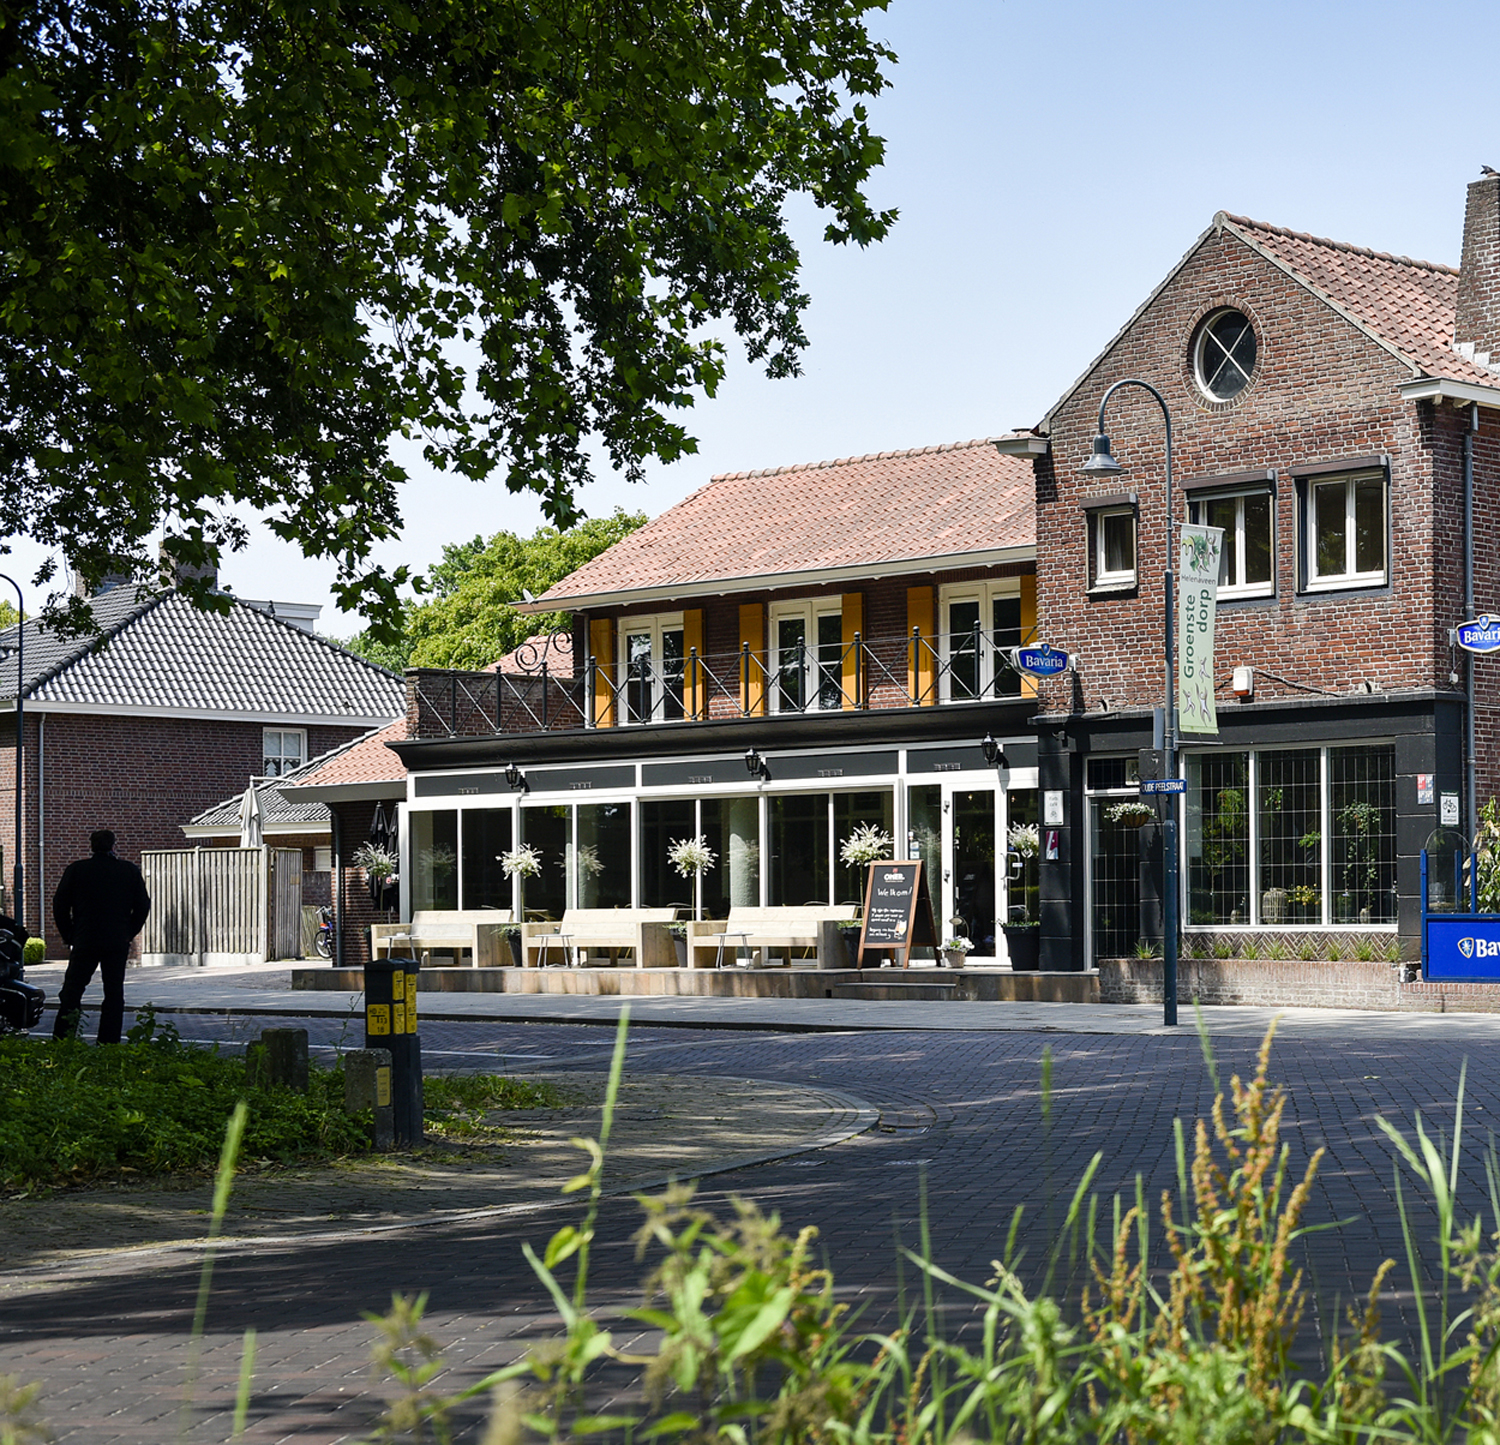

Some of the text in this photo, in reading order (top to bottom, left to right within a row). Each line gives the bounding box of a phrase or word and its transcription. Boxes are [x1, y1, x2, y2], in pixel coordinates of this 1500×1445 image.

[1196, 589, 1212, 633] dorp
[1183, 594, 1196, 679] Groenste
[1025, 655, 1064, 668] Bavaria
